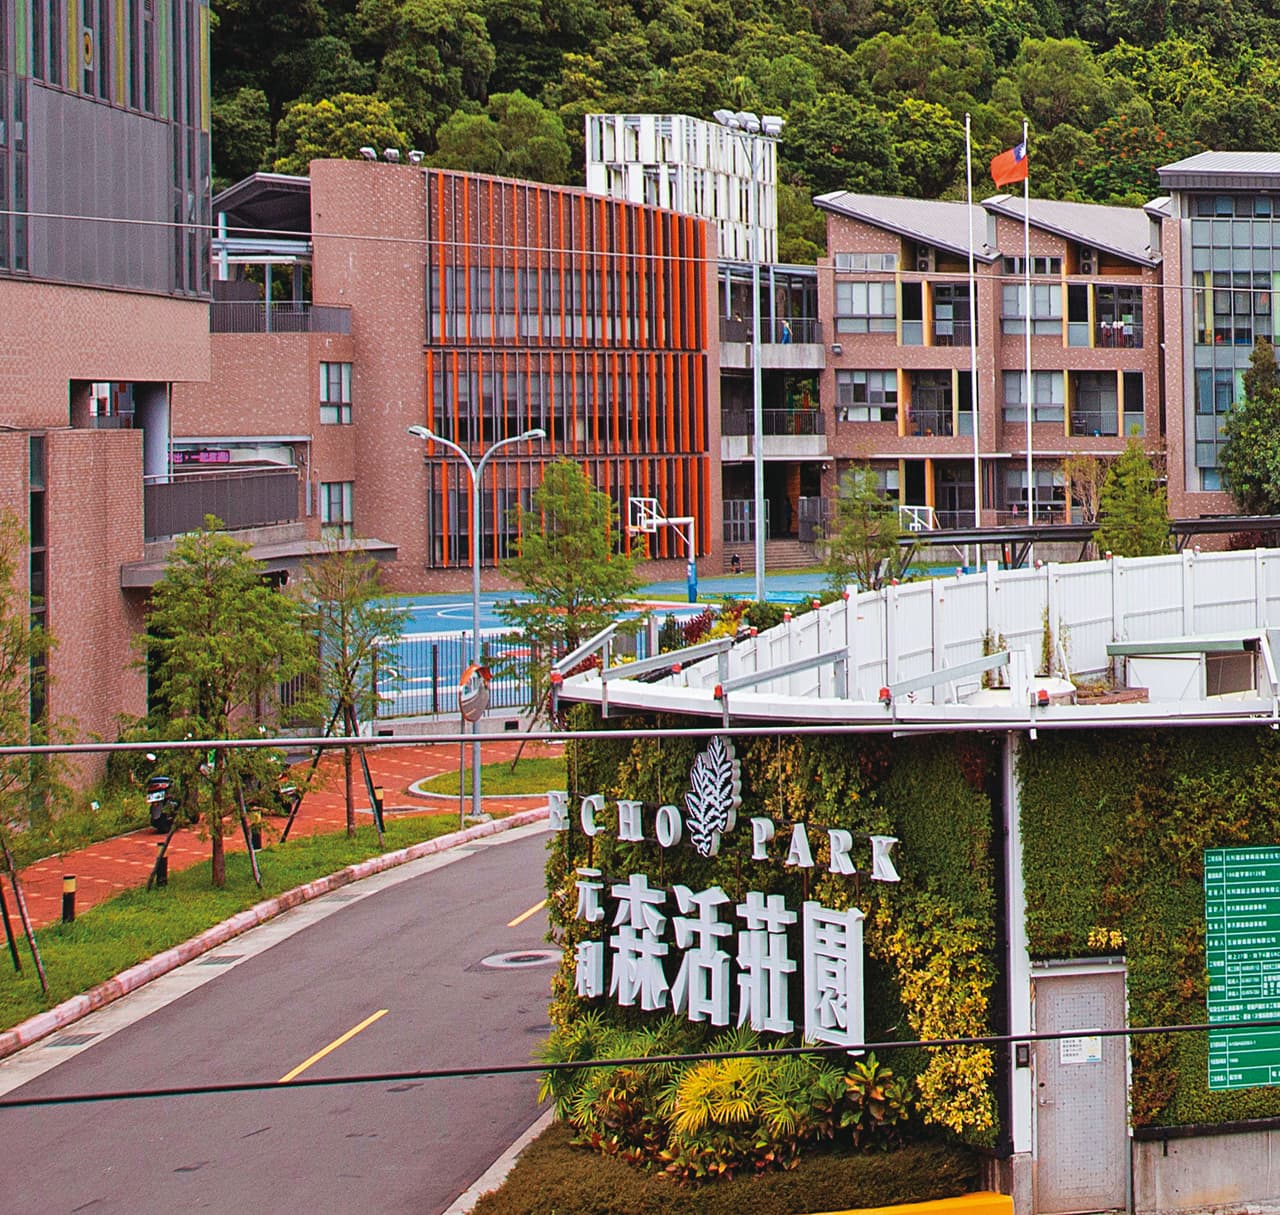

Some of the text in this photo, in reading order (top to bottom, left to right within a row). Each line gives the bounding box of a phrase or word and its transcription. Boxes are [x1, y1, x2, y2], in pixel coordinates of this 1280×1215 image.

[548, 791, 901, 882] ECHO PARK
[609, 873, 865, 1056] 森活莊園
